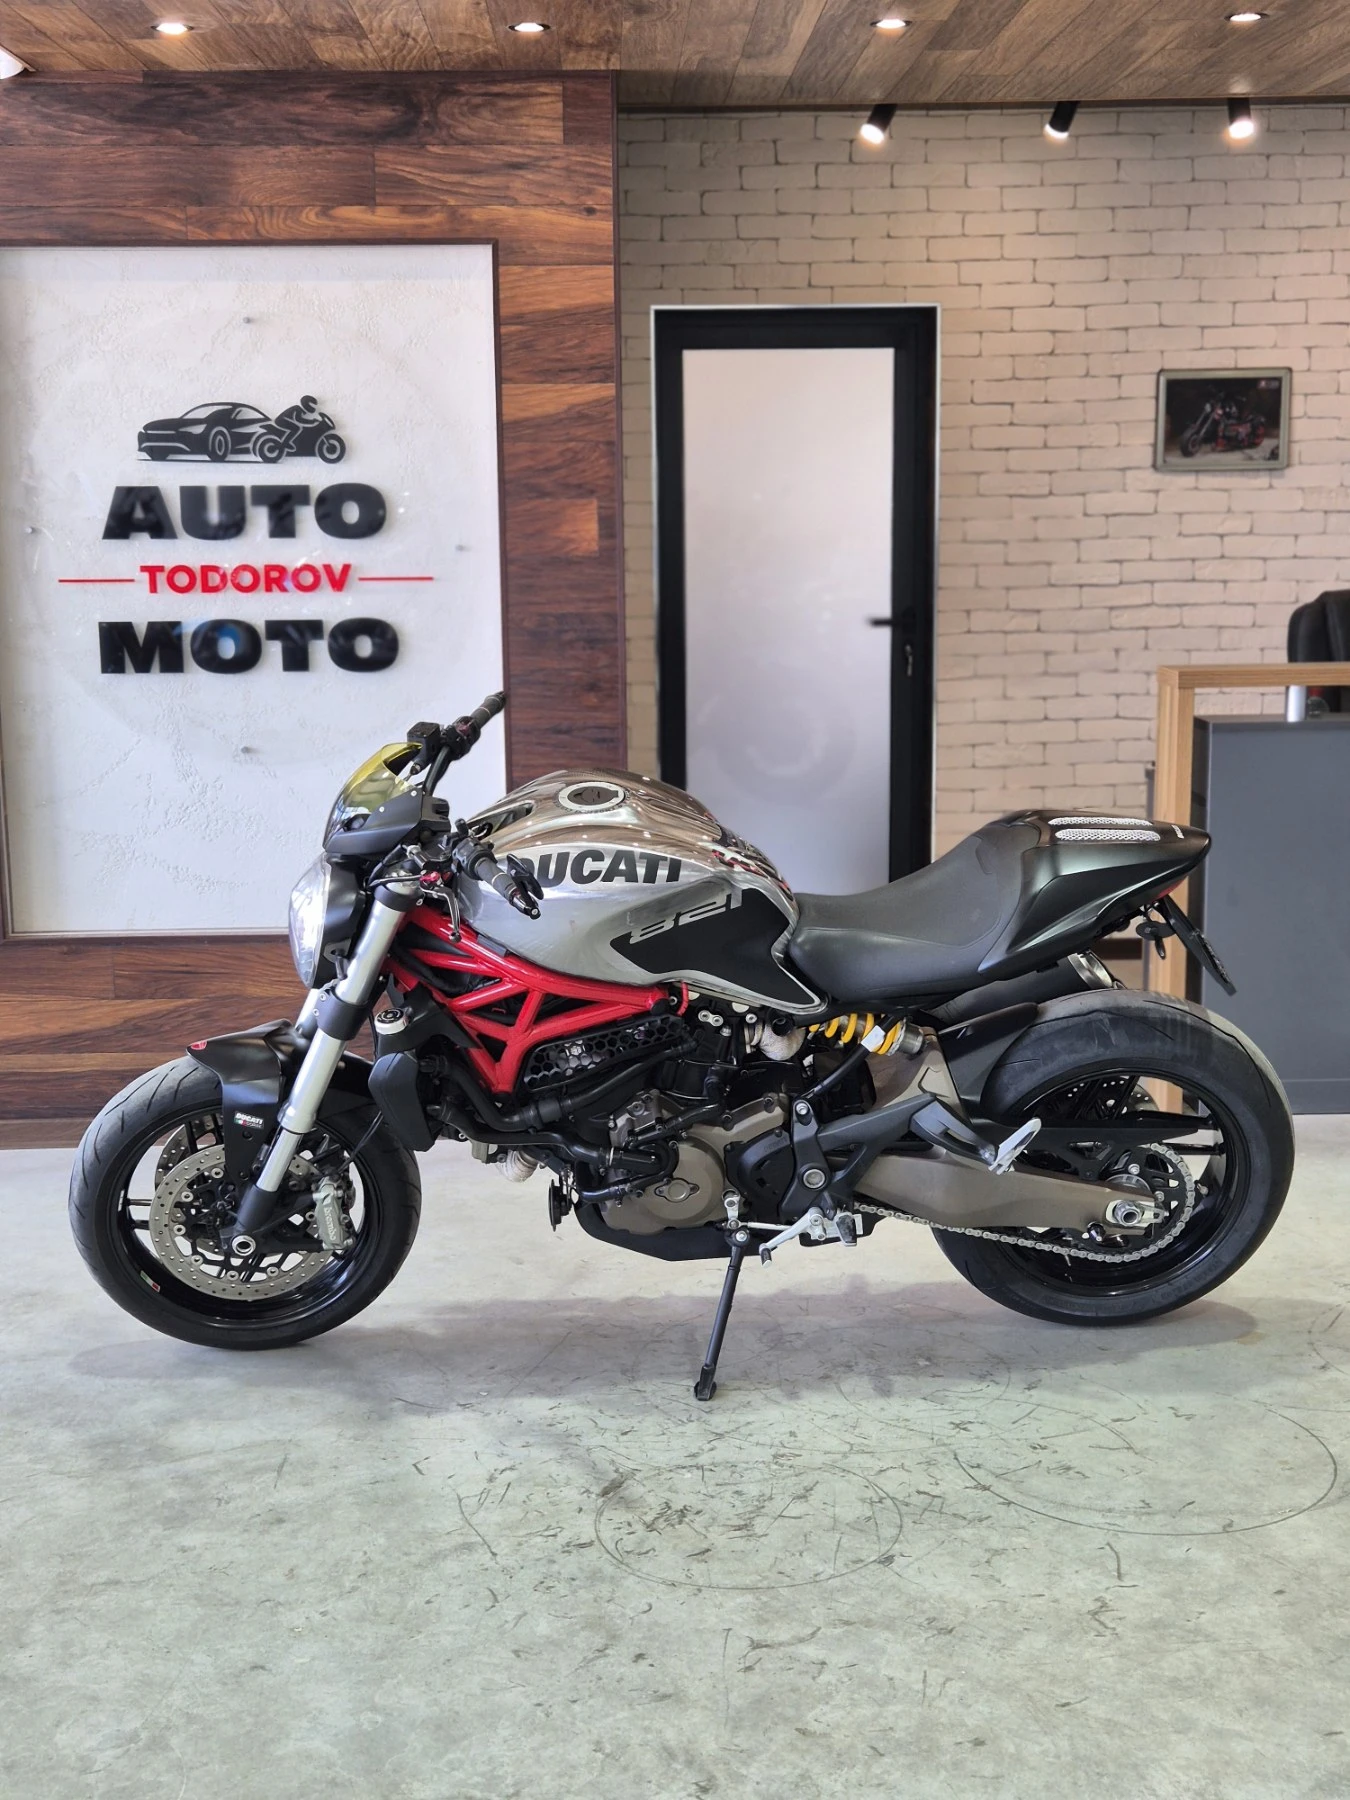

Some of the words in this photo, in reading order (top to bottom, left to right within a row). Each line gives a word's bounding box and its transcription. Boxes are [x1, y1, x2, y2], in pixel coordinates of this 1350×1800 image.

[102, 482, 386, 540] AUTO
[140, 563, 352, 594] TODOROV
[98, 617, 399, 674] MOTO
[235, 1112, 263, 1125] DUCATI
